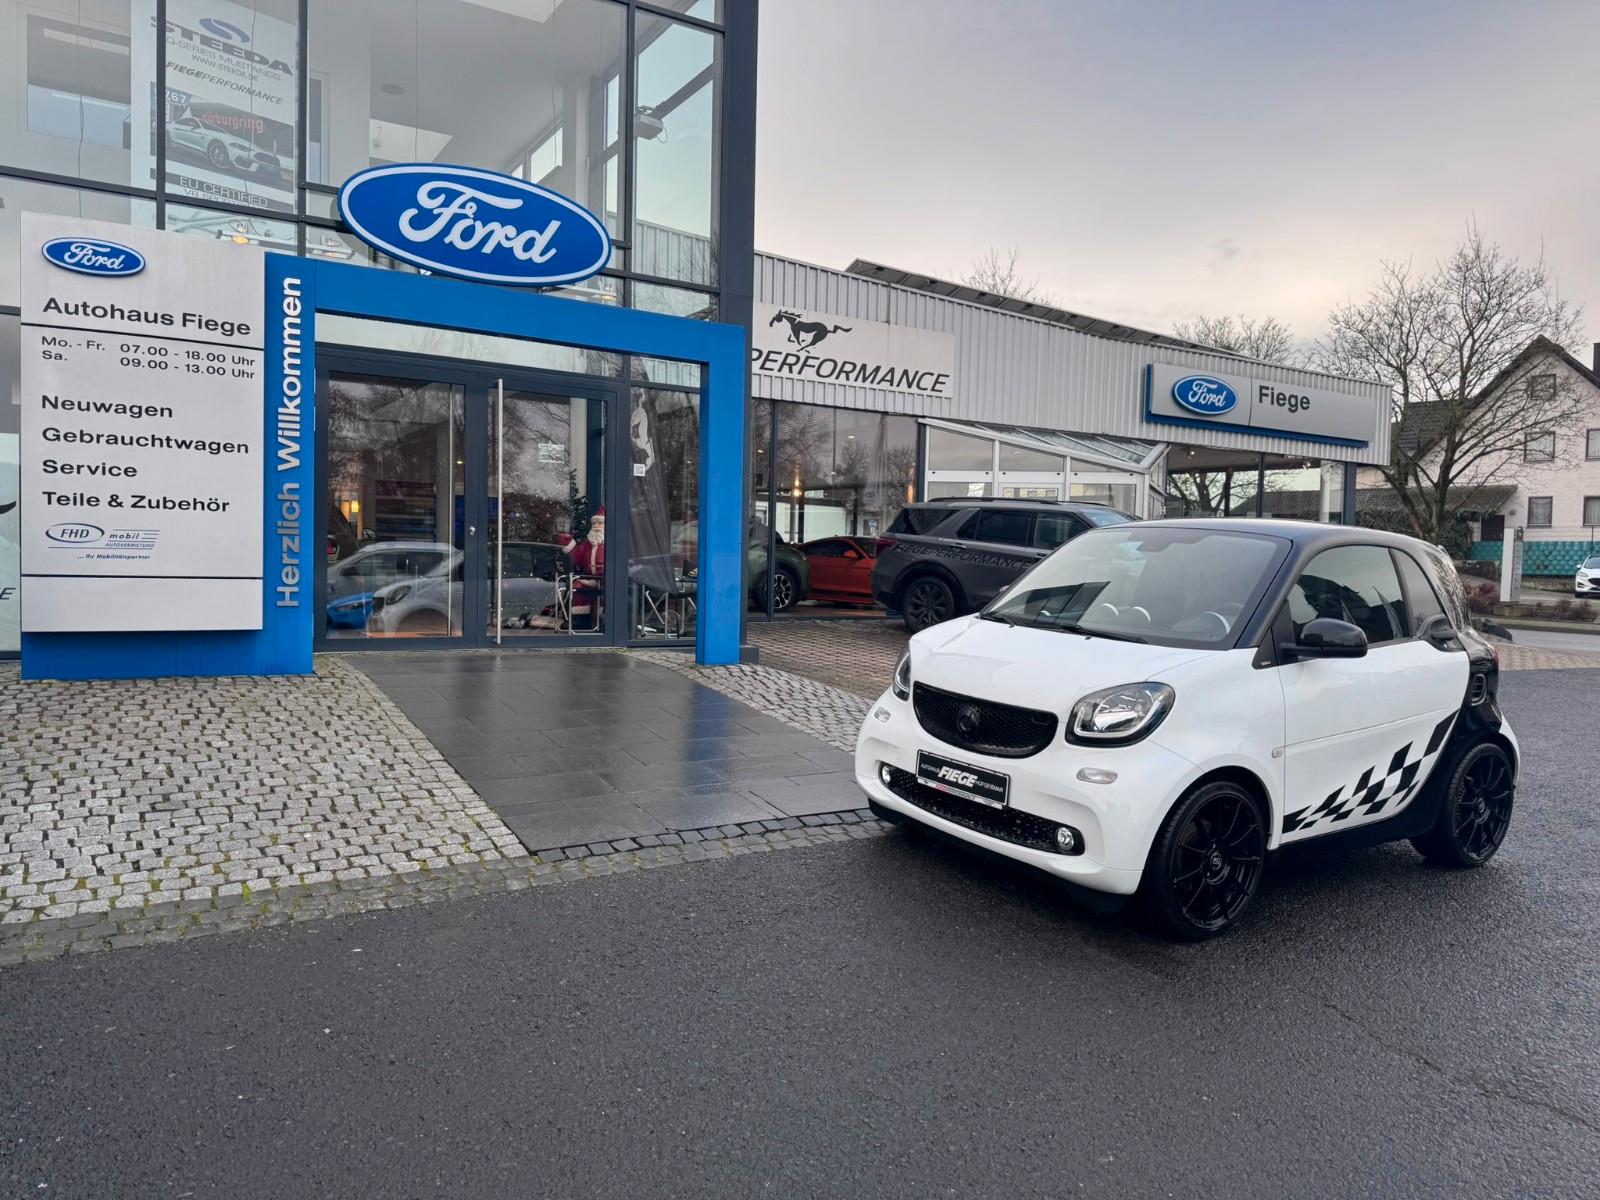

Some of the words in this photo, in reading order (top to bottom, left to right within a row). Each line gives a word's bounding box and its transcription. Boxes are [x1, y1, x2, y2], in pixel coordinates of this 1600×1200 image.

[150, 16, 294, 76] STEEDA
[180, 176, 199, 189] EU
[203, 182, 268, 207] CERTIFIED
[399, 180, 562, 265] Ford
[63, 243, 127, 272] Ford
[42, 297, 175, 327] Autohaus
[181, 313, 252, 337] Fiege
[41, 336, 73, 348] Mo.
[86, 340, 106, 351] Fr.
[120, 343, 169, 358] 07.00
[185, 350, 226, 364] 18.00
[231, 353, 256, 367] Uhr
[41, 350, 68, 362] Sa.
[120, 356, 169, 371] 09.00
[185, 363, 226, 377] 13.00
[231, 367, 256, 380] Uhr
[277, 276, 302, 472] Willkommen
[752, 347, 951, 394] PERFORMANCE
[41, 395, 173, 419] Neuwagen
[1187, 381, 1228, 408] Ford
[1258, 385, 1311, 413] Fiege
[41, 427, 250, 455] Gebrauchtwagen
[41, 459, 138, 478] Service
[42, 491, 101, 508] Teile
[107, 494, 125, 509] &
[130, 494, 231, 513] Zubehör
[60, 528, 90, 539] FHD
[109, 532, 141, 540] mobil
[276, 482, 301, 608] Herzlich
[937, 766, 979, 788] FIEGE
